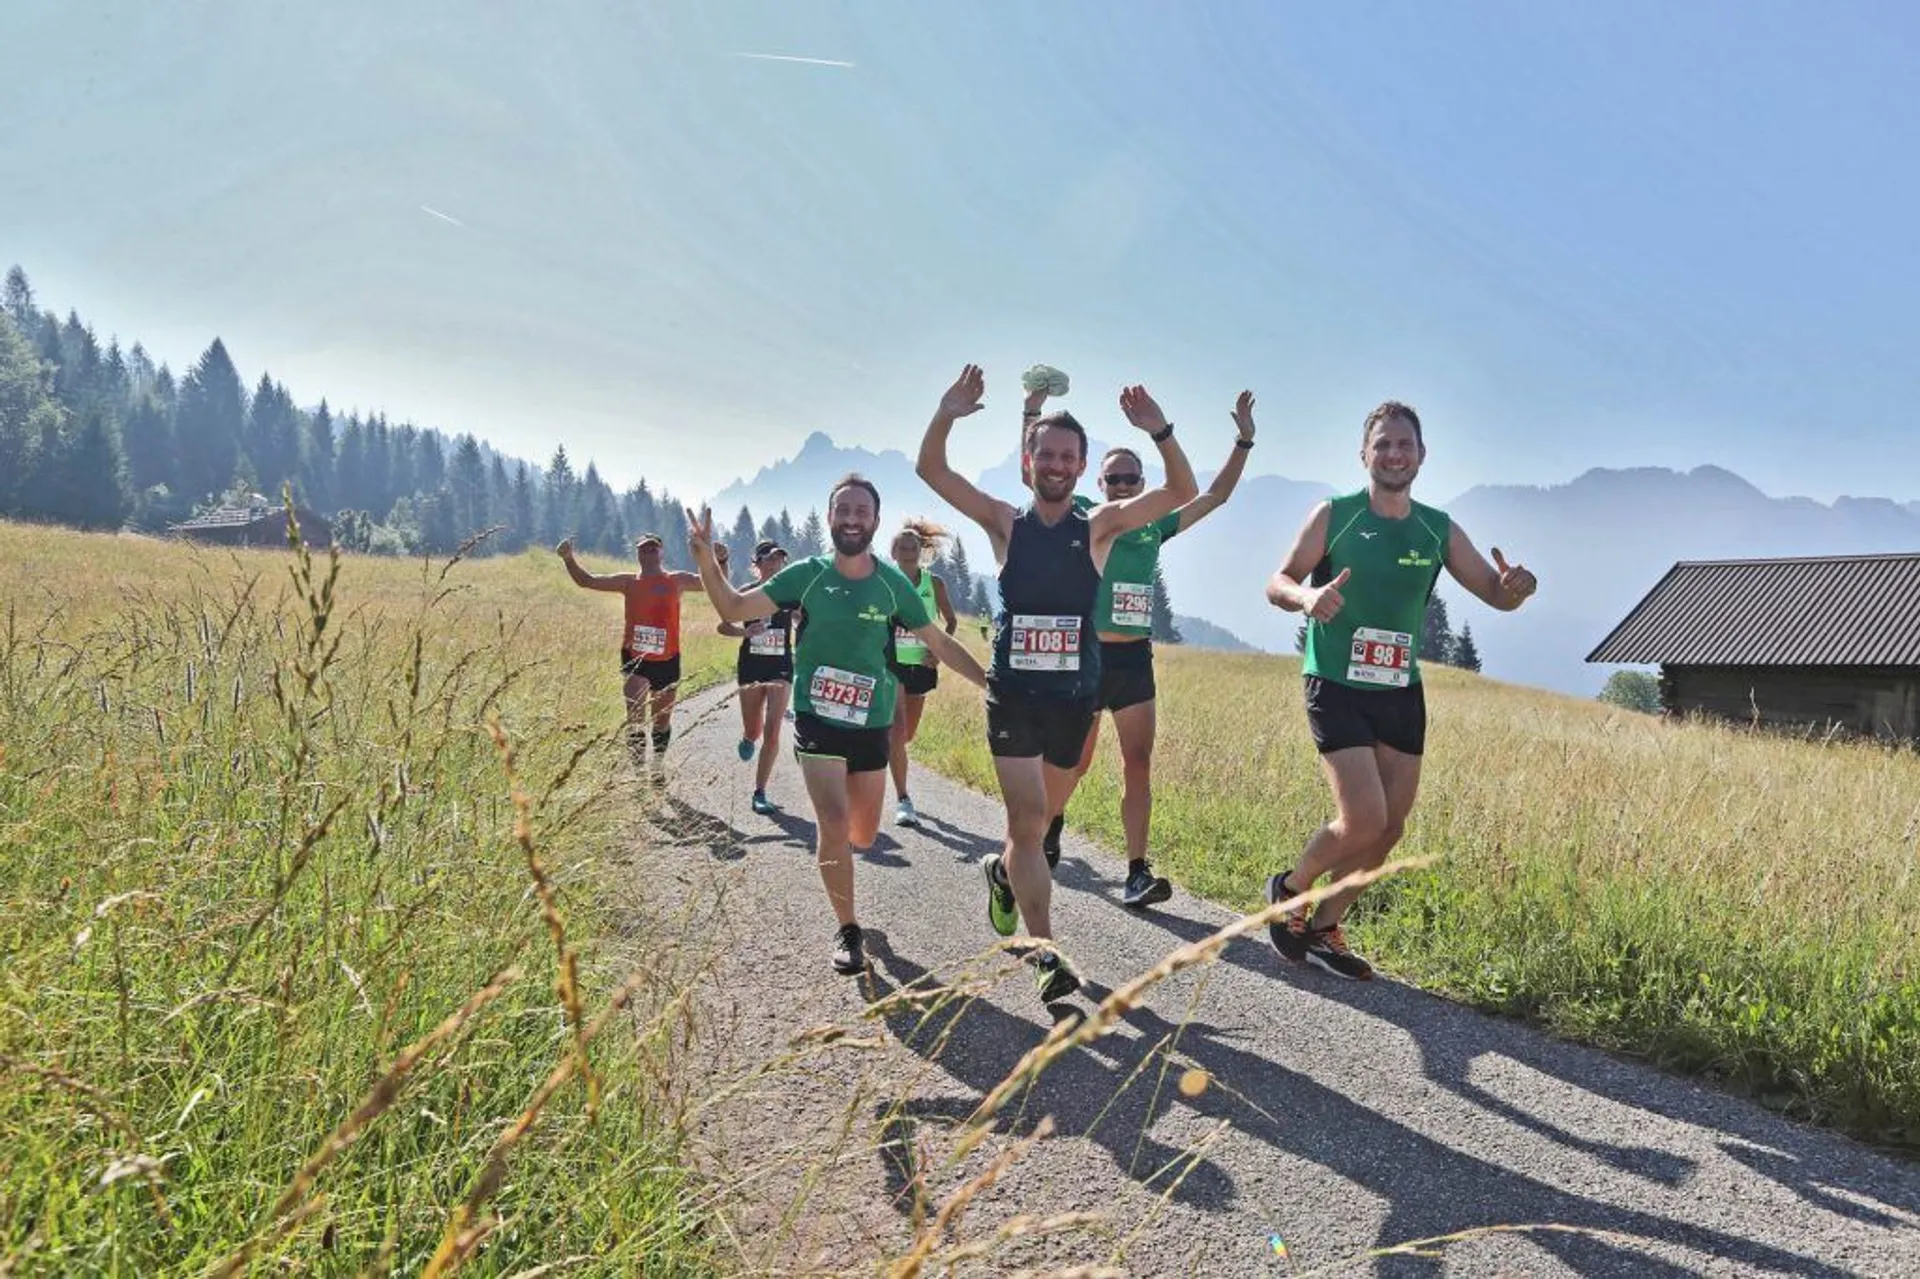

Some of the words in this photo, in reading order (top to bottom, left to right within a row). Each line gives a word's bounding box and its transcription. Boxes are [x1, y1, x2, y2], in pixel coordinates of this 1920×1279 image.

[1125, 594, 1147, 612] 296
[1028, 630, 1063, 652] 108
[1373, 644, 1395, 667] 98
[824, 681, 857, 704] 373
